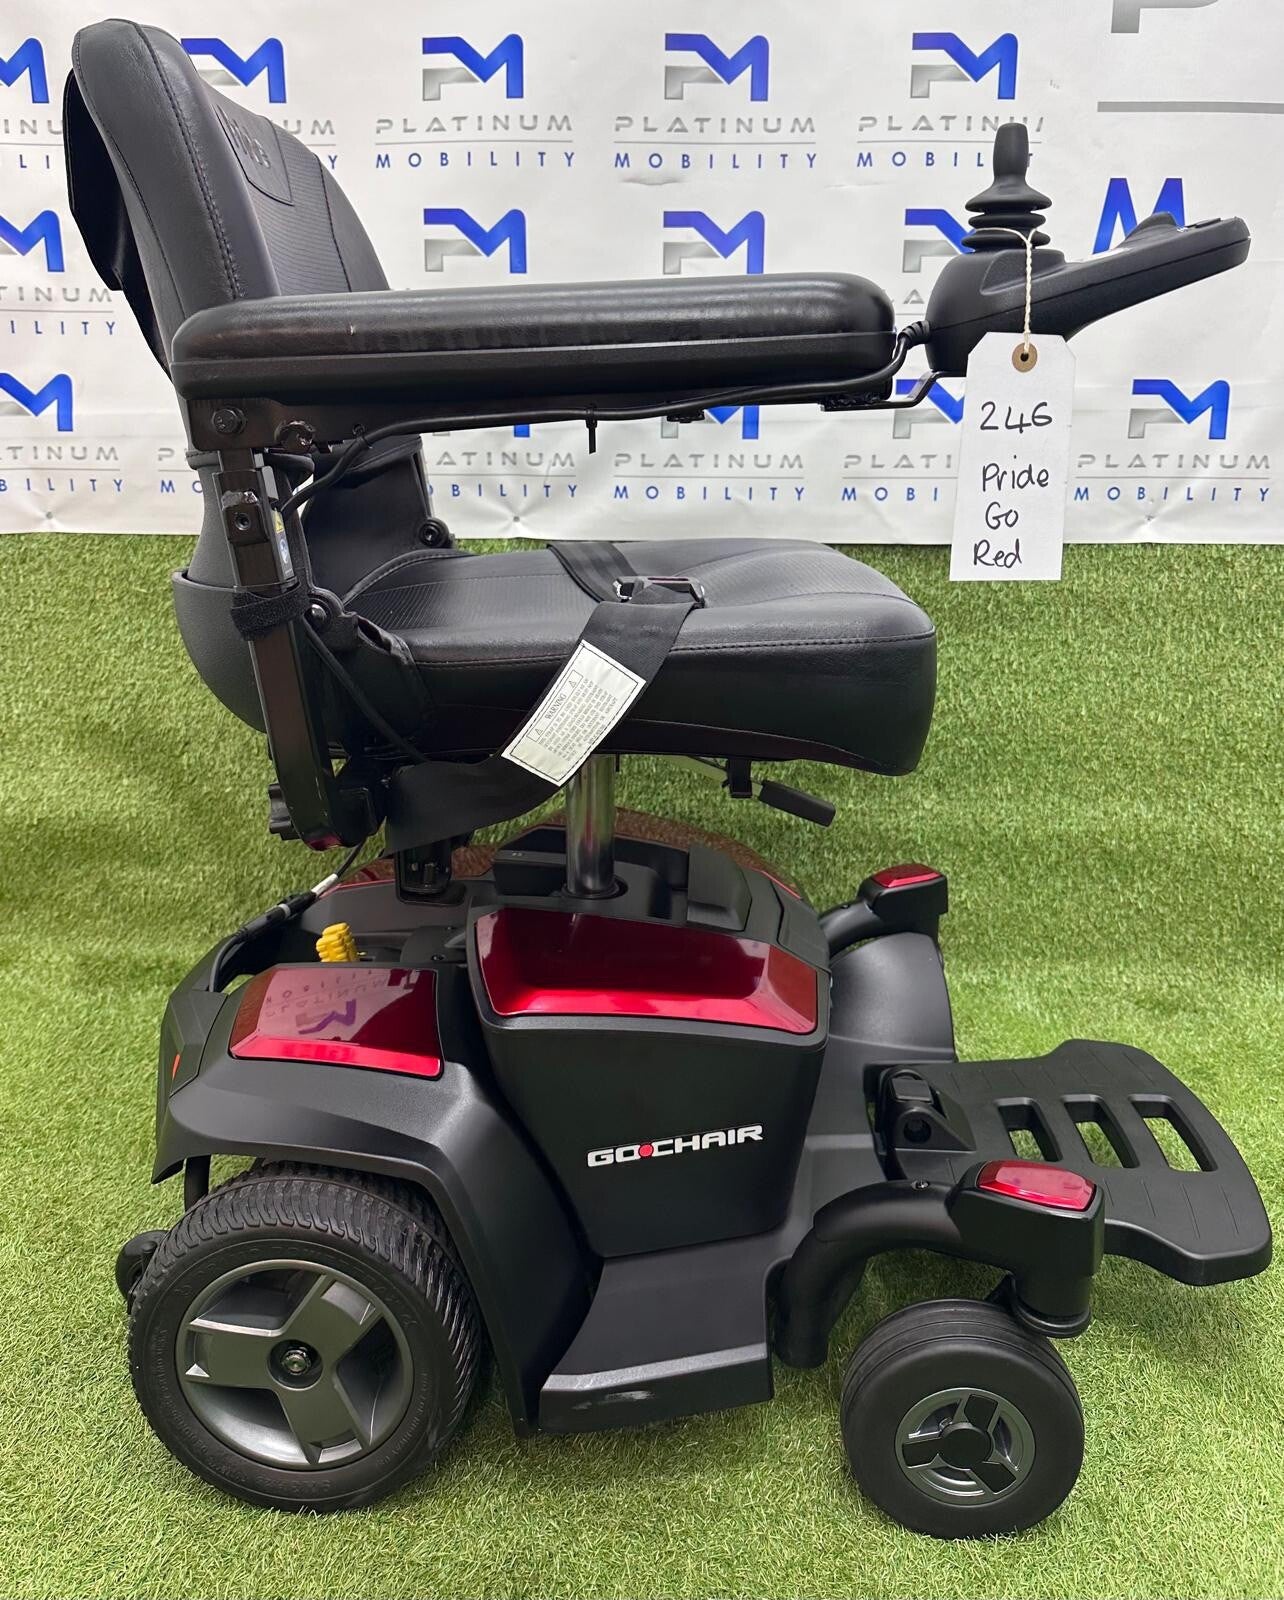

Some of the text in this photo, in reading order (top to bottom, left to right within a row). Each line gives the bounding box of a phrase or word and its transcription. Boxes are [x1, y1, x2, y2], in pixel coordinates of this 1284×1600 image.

[375, 114, 573, 135] PLATINUM
[614, 115, 816, 134] PLATINUM
[857, 115, 1044, 133] PLATIN
[375, 151, 575, 169] MOBILITY
[614, 152, 818, 169] MOBILITY
[857, 151, 1033, 168] MOBIL
[979, 401, 1053, 432] 246
[0, 445, 118, 461] TINUM
[613, 452, 804, 469] PLATINUM
[1077, 453, 1271, 469] PLATINUM
[981, 454, 1050, 493] Pride
[613, 485, 805, 501] MOBILITY
[1074, 487, 1271, 502] MOBILITY
[985, 501, 1019, 530] Go
[972, 538, 1023, 569] Red
